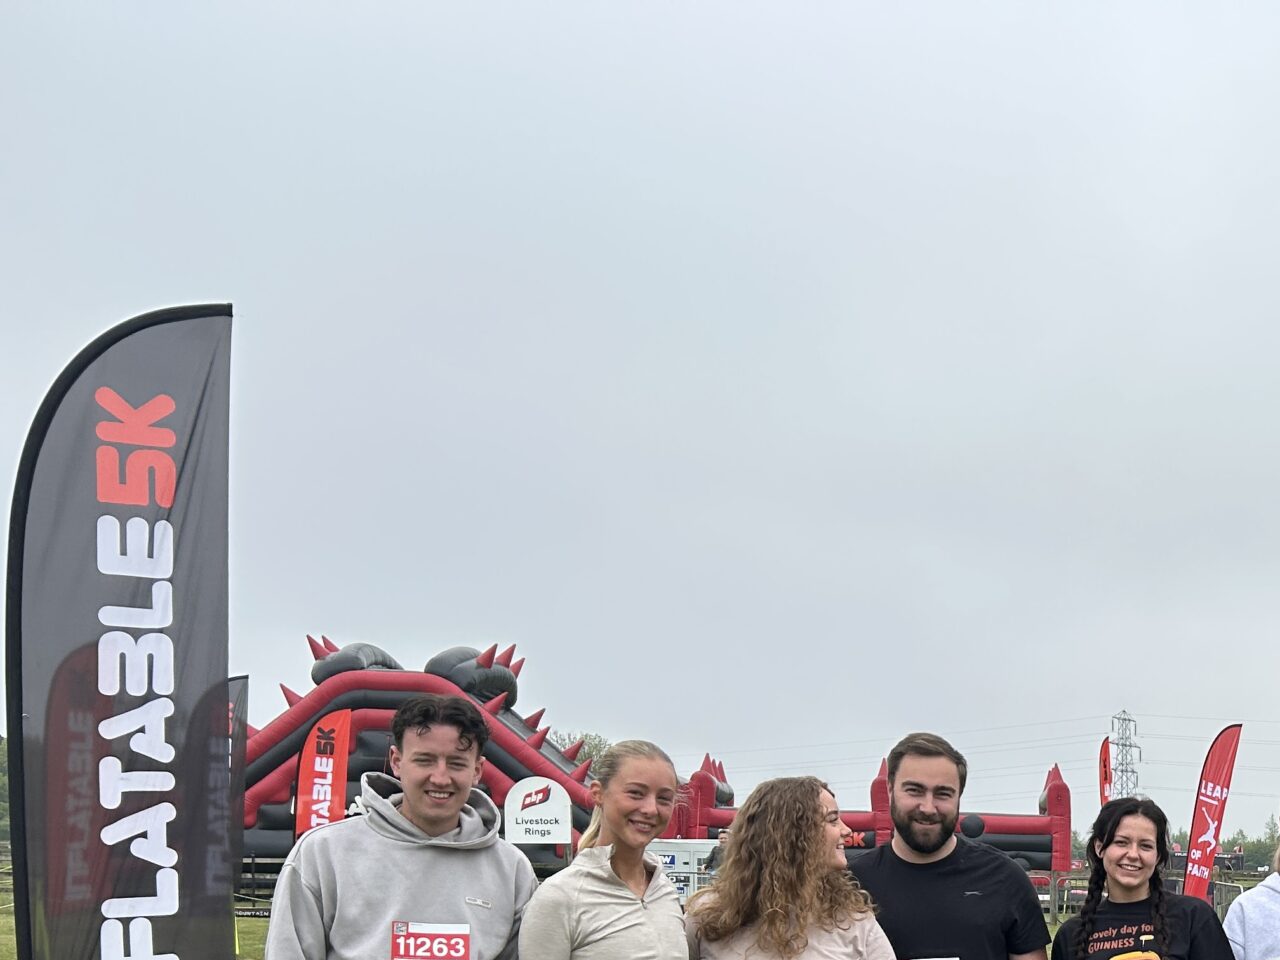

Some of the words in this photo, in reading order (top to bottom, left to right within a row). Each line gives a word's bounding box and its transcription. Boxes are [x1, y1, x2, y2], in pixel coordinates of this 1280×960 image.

[515, 817, 560, 825] Livestock
[524, 827, 551, 837] Rings
[1120, 925, 1138, 935] day
[396, 936, 465, 957] 11263
[1088, 938, 1135, 954] GUINNESS
